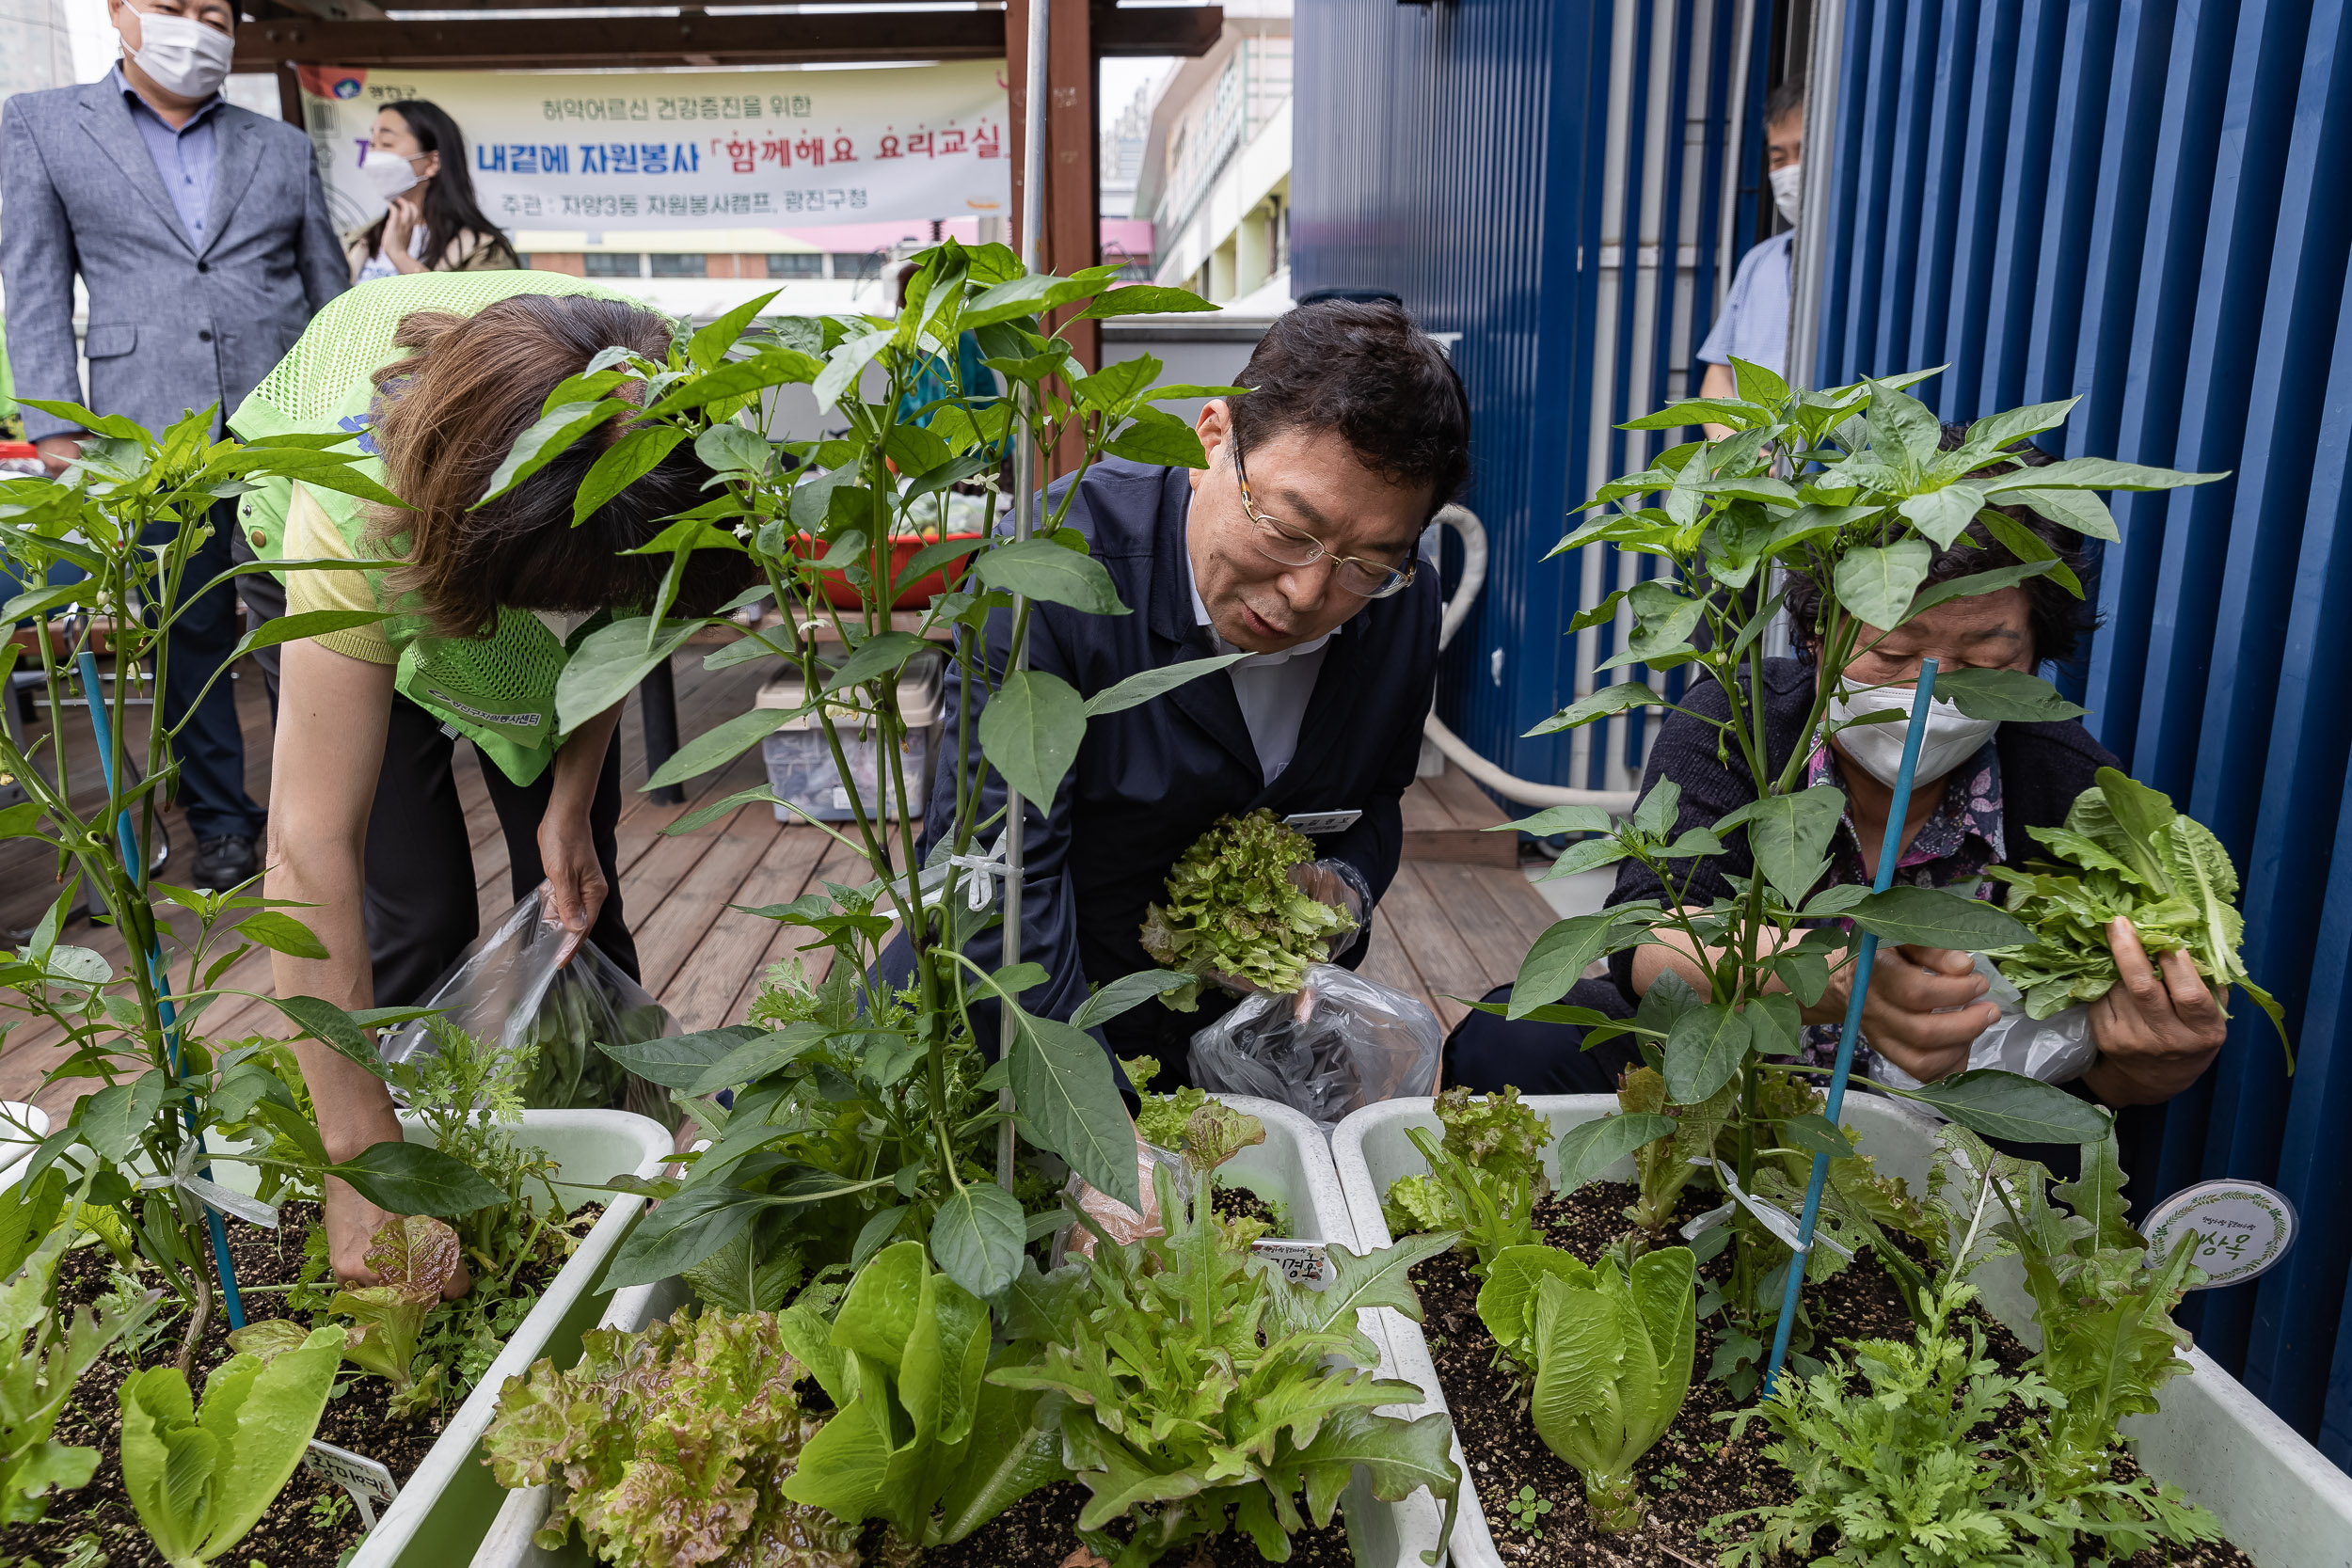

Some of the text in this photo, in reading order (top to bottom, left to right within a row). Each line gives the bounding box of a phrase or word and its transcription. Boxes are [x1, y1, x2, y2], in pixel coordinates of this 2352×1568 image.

[542, 95, 812, 120] 허약어르신 건강증진을 위한
[477, 144, 568, 173] 내곁에
[580, 143, 699, 173] 자원봉사
[501, 194, 542, 216] 주관
[563, 194, 638, 216] 자양3동
[647, 191, 778, 216] 자원봉사캠프,
[784, 188, 867, 212] 광진구청
